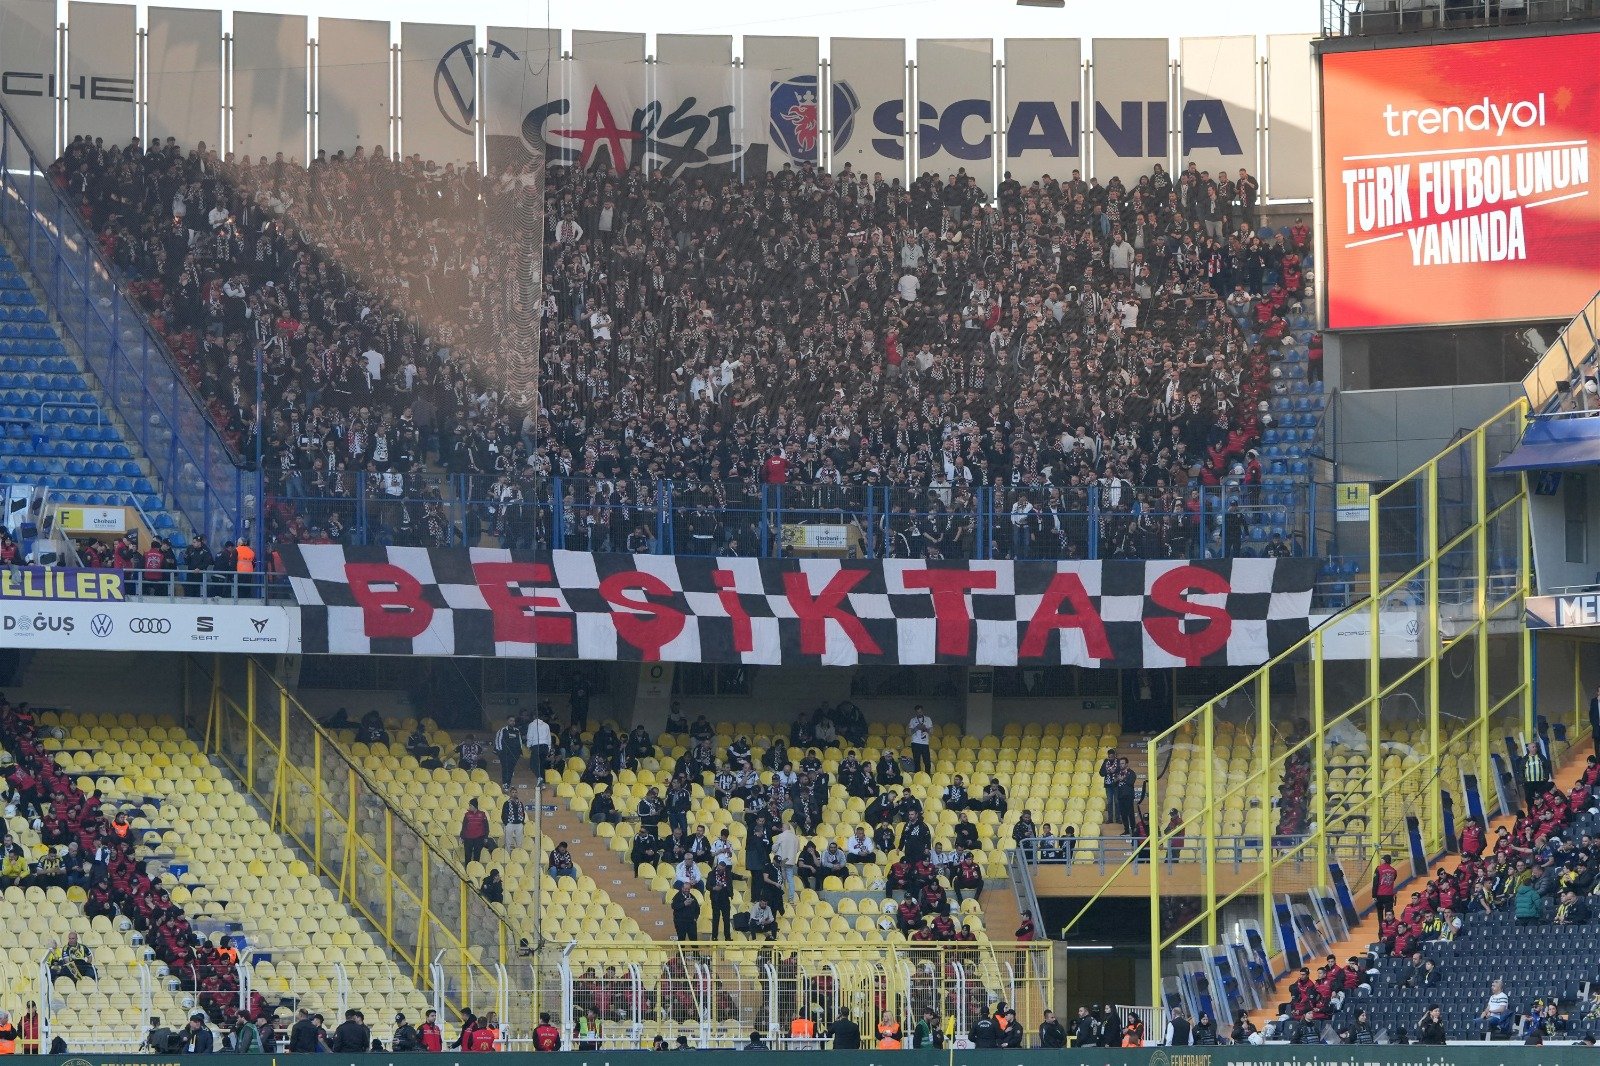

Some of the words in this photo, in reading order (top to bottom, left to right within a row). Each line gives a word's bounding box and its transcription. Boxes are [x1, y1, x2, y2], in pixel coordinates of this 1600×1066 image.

[871, 99, 1243, 160] SCANIA
[1383, 92, 1546, 137] trendyol
[1342, 163, 1413, 235] TÜRK
[1418, 146, 1589, 219] FUTBOLUNUN
[1407, 205, 1527, 266] YANINDA
[1347, 486, 1358, 500] H
[61, 511, 70, 524] F
[1559, 594, 1600, 627] ME
